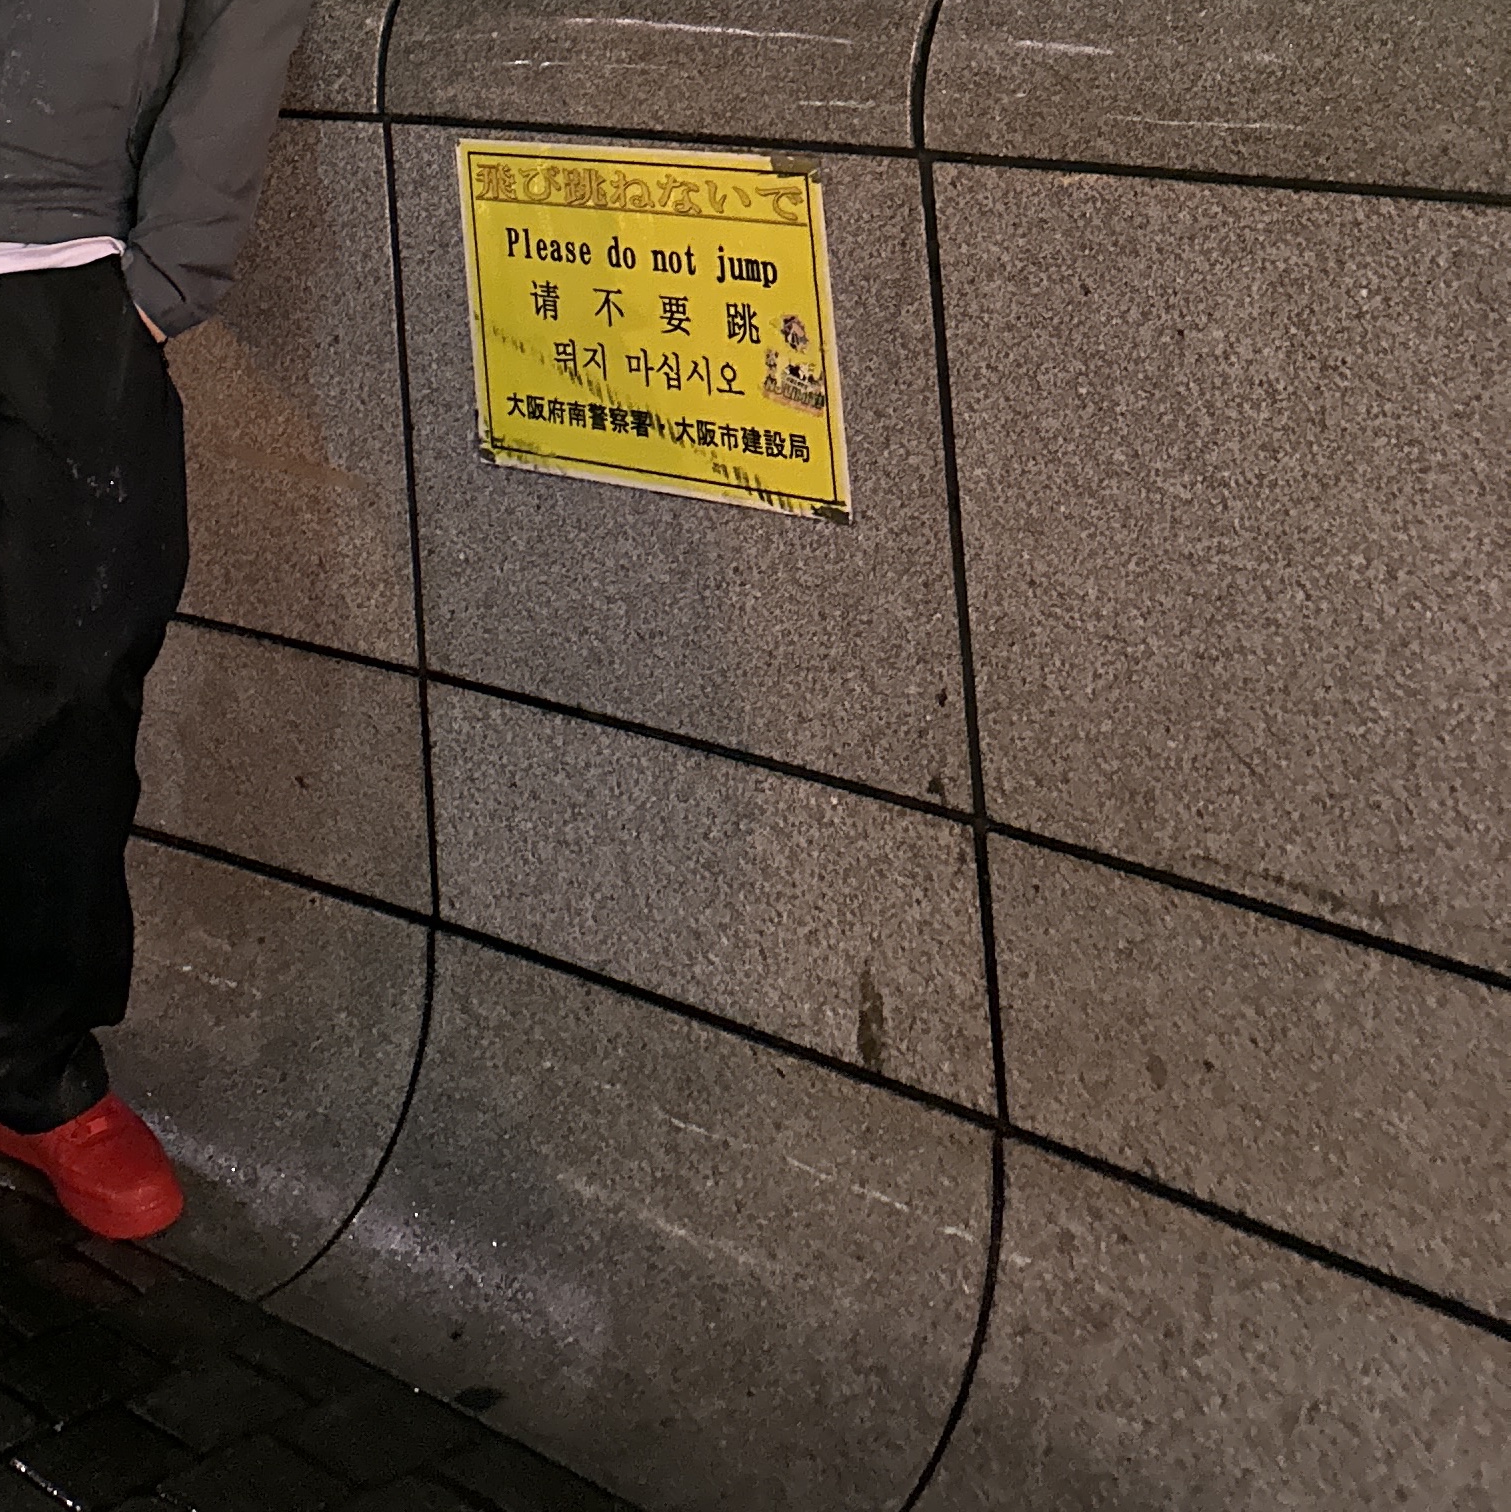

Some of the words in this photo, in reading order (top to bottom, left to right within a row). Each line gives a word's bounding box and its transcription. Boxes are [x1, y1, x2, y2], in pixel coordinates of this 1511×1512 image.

[476, 162, 804, 221] 飛び跳ねないで
[506, 228, 592, 265] Please
[608, 236, 636, 269] do
[652, 245, 696, 275] not
[716, 245, 777, 287] jump
[625, 349, 745, 396] 마십시오
